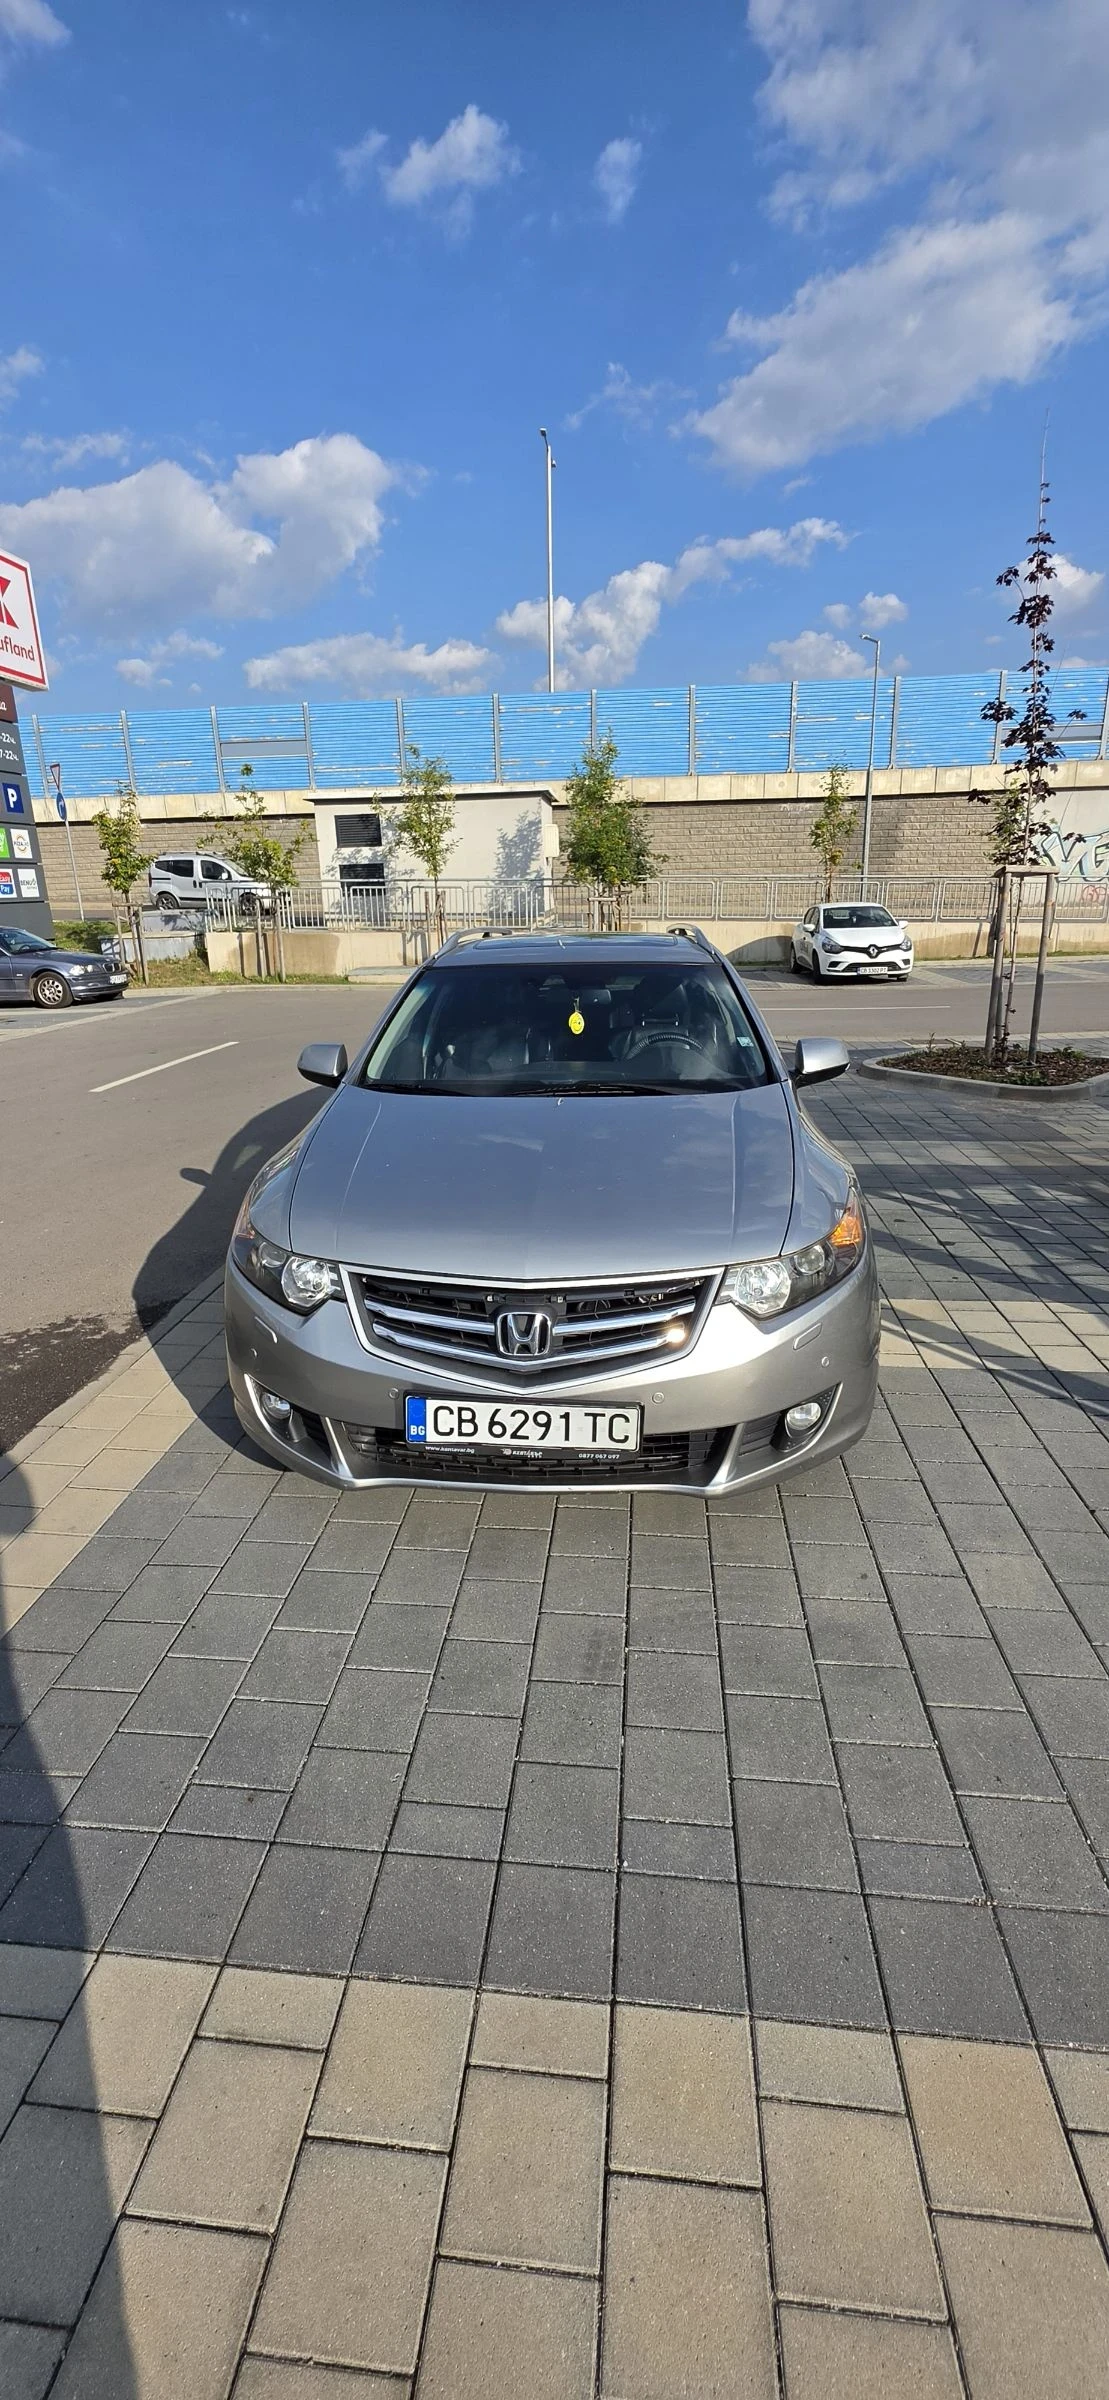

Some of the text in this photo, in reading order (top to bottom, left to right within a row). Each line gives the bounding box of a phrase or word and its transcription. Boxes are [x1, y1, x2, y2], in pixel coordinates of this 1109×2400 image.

[7, 788, 18, 808] P
[410, 1425, 425, 1436] BG
[433, 1405, 630, 1444] CB 6291 TC
